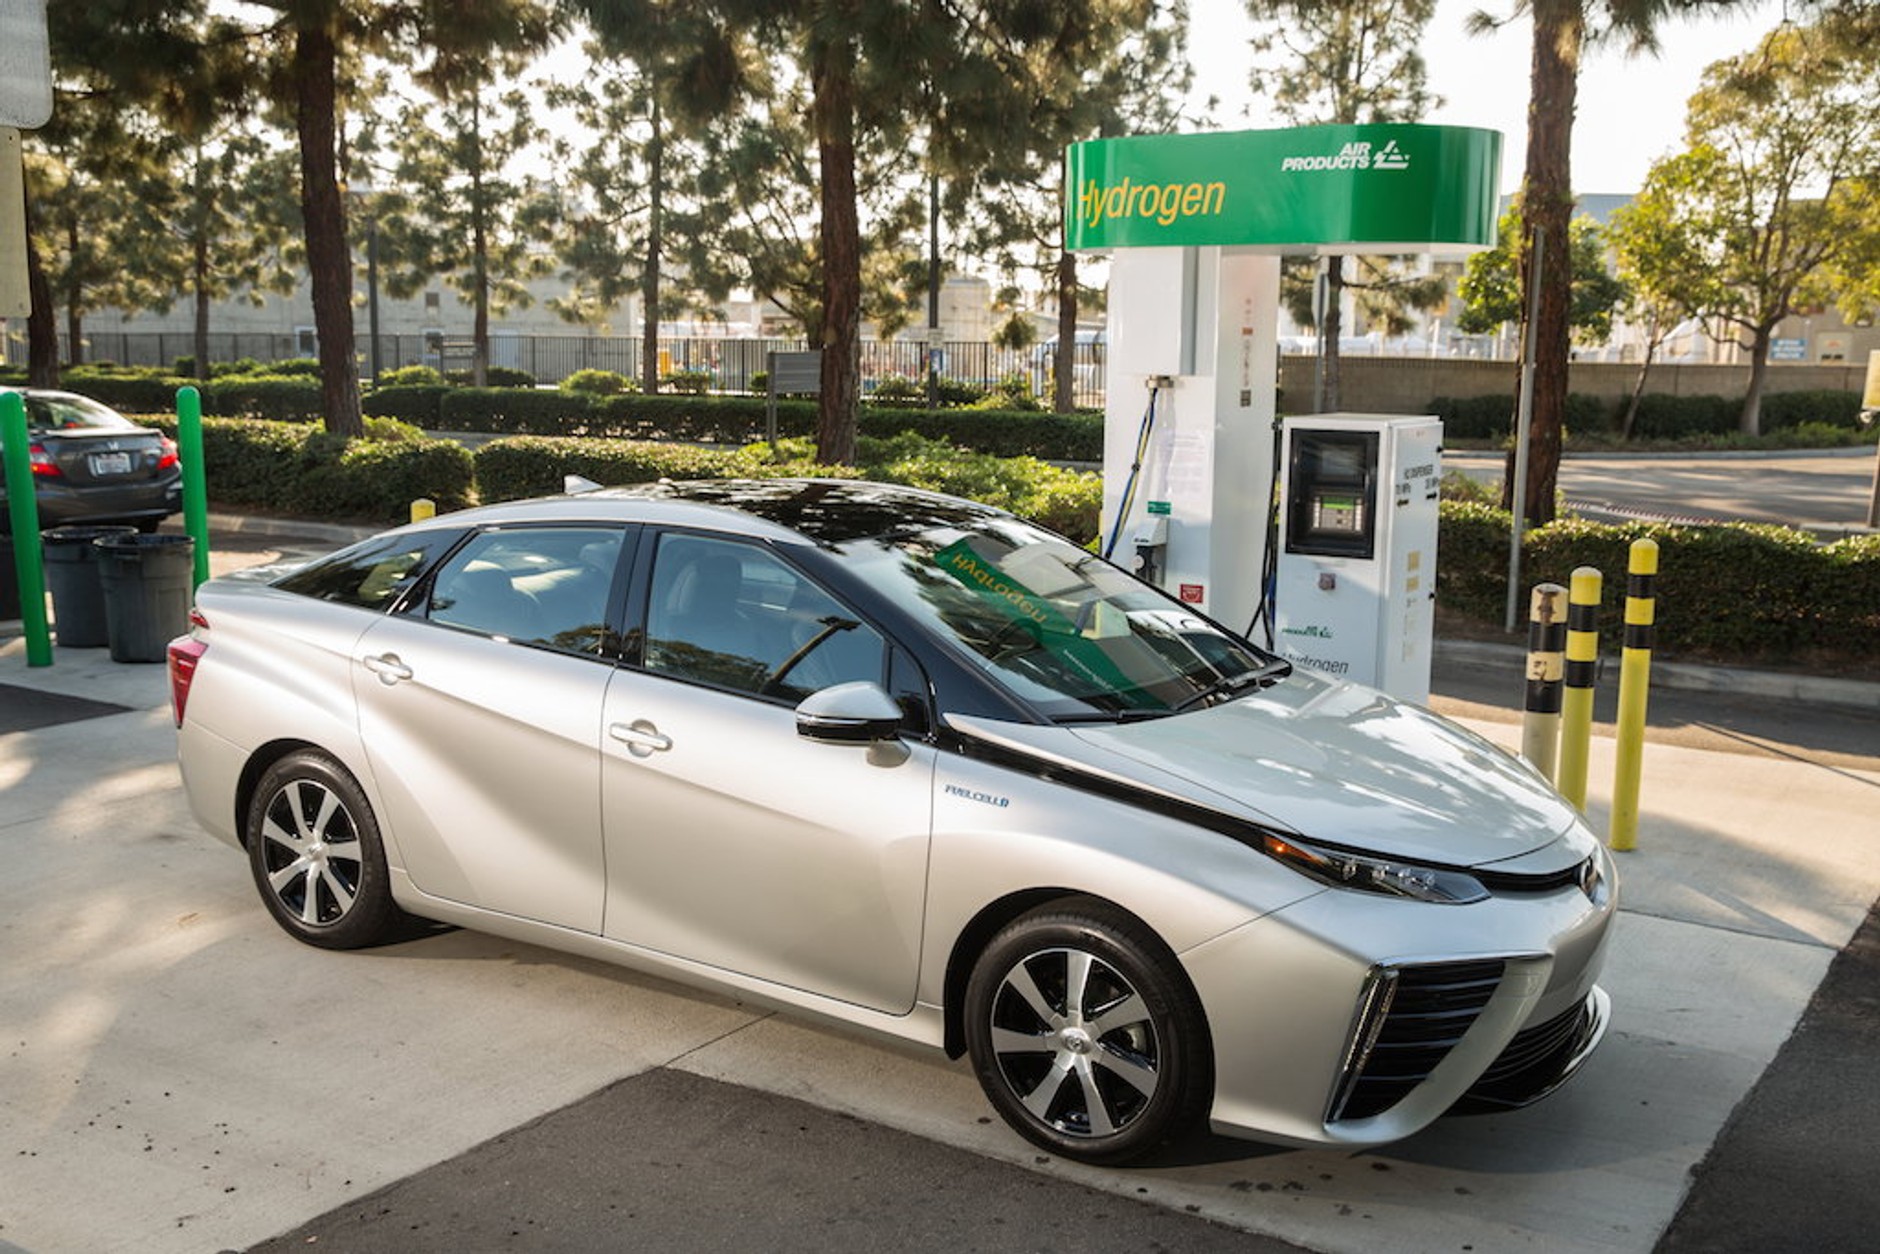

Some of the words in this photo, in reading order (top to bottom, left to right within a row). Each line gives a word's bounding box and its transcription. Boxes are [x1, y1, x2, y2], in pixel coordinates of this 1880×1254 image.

[1339, 142, 1371, 155] AIR
[1281, 156, 1370, 171] PRODUCTS
[1077, 176, 1226, 228] Hydrogen
